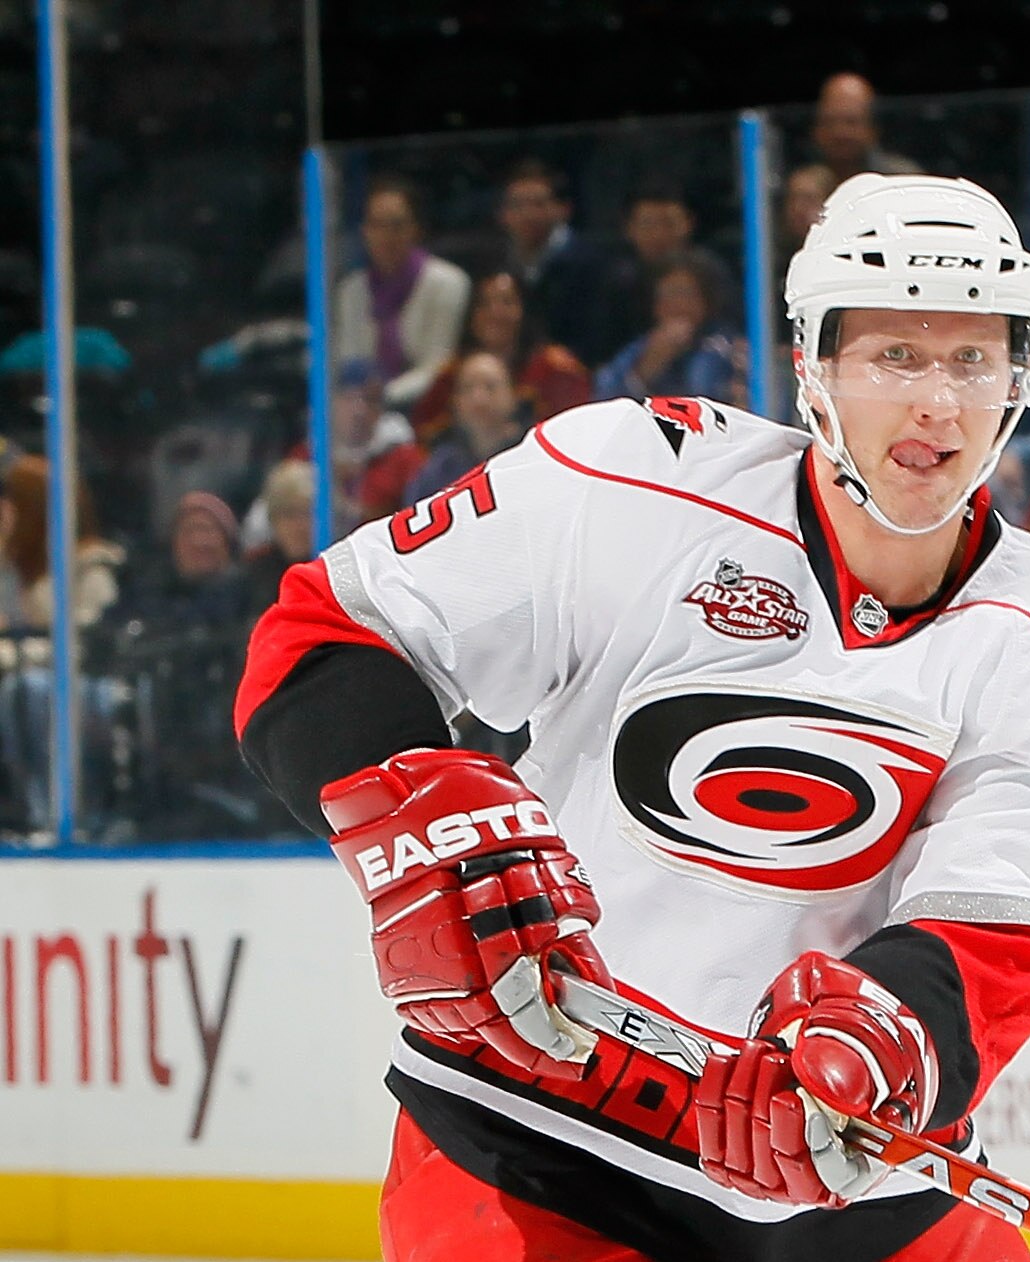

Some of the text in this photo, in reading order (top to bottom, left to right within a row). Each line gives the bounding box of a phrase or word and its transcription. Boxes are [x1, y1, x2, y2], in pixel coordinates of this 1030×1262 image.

[907, 254, 984, 271] CCM
[692, 583, 732, 606] ALL
[758, 599, 808, 630] STAR
[727, 610, 770, 628] GAME
